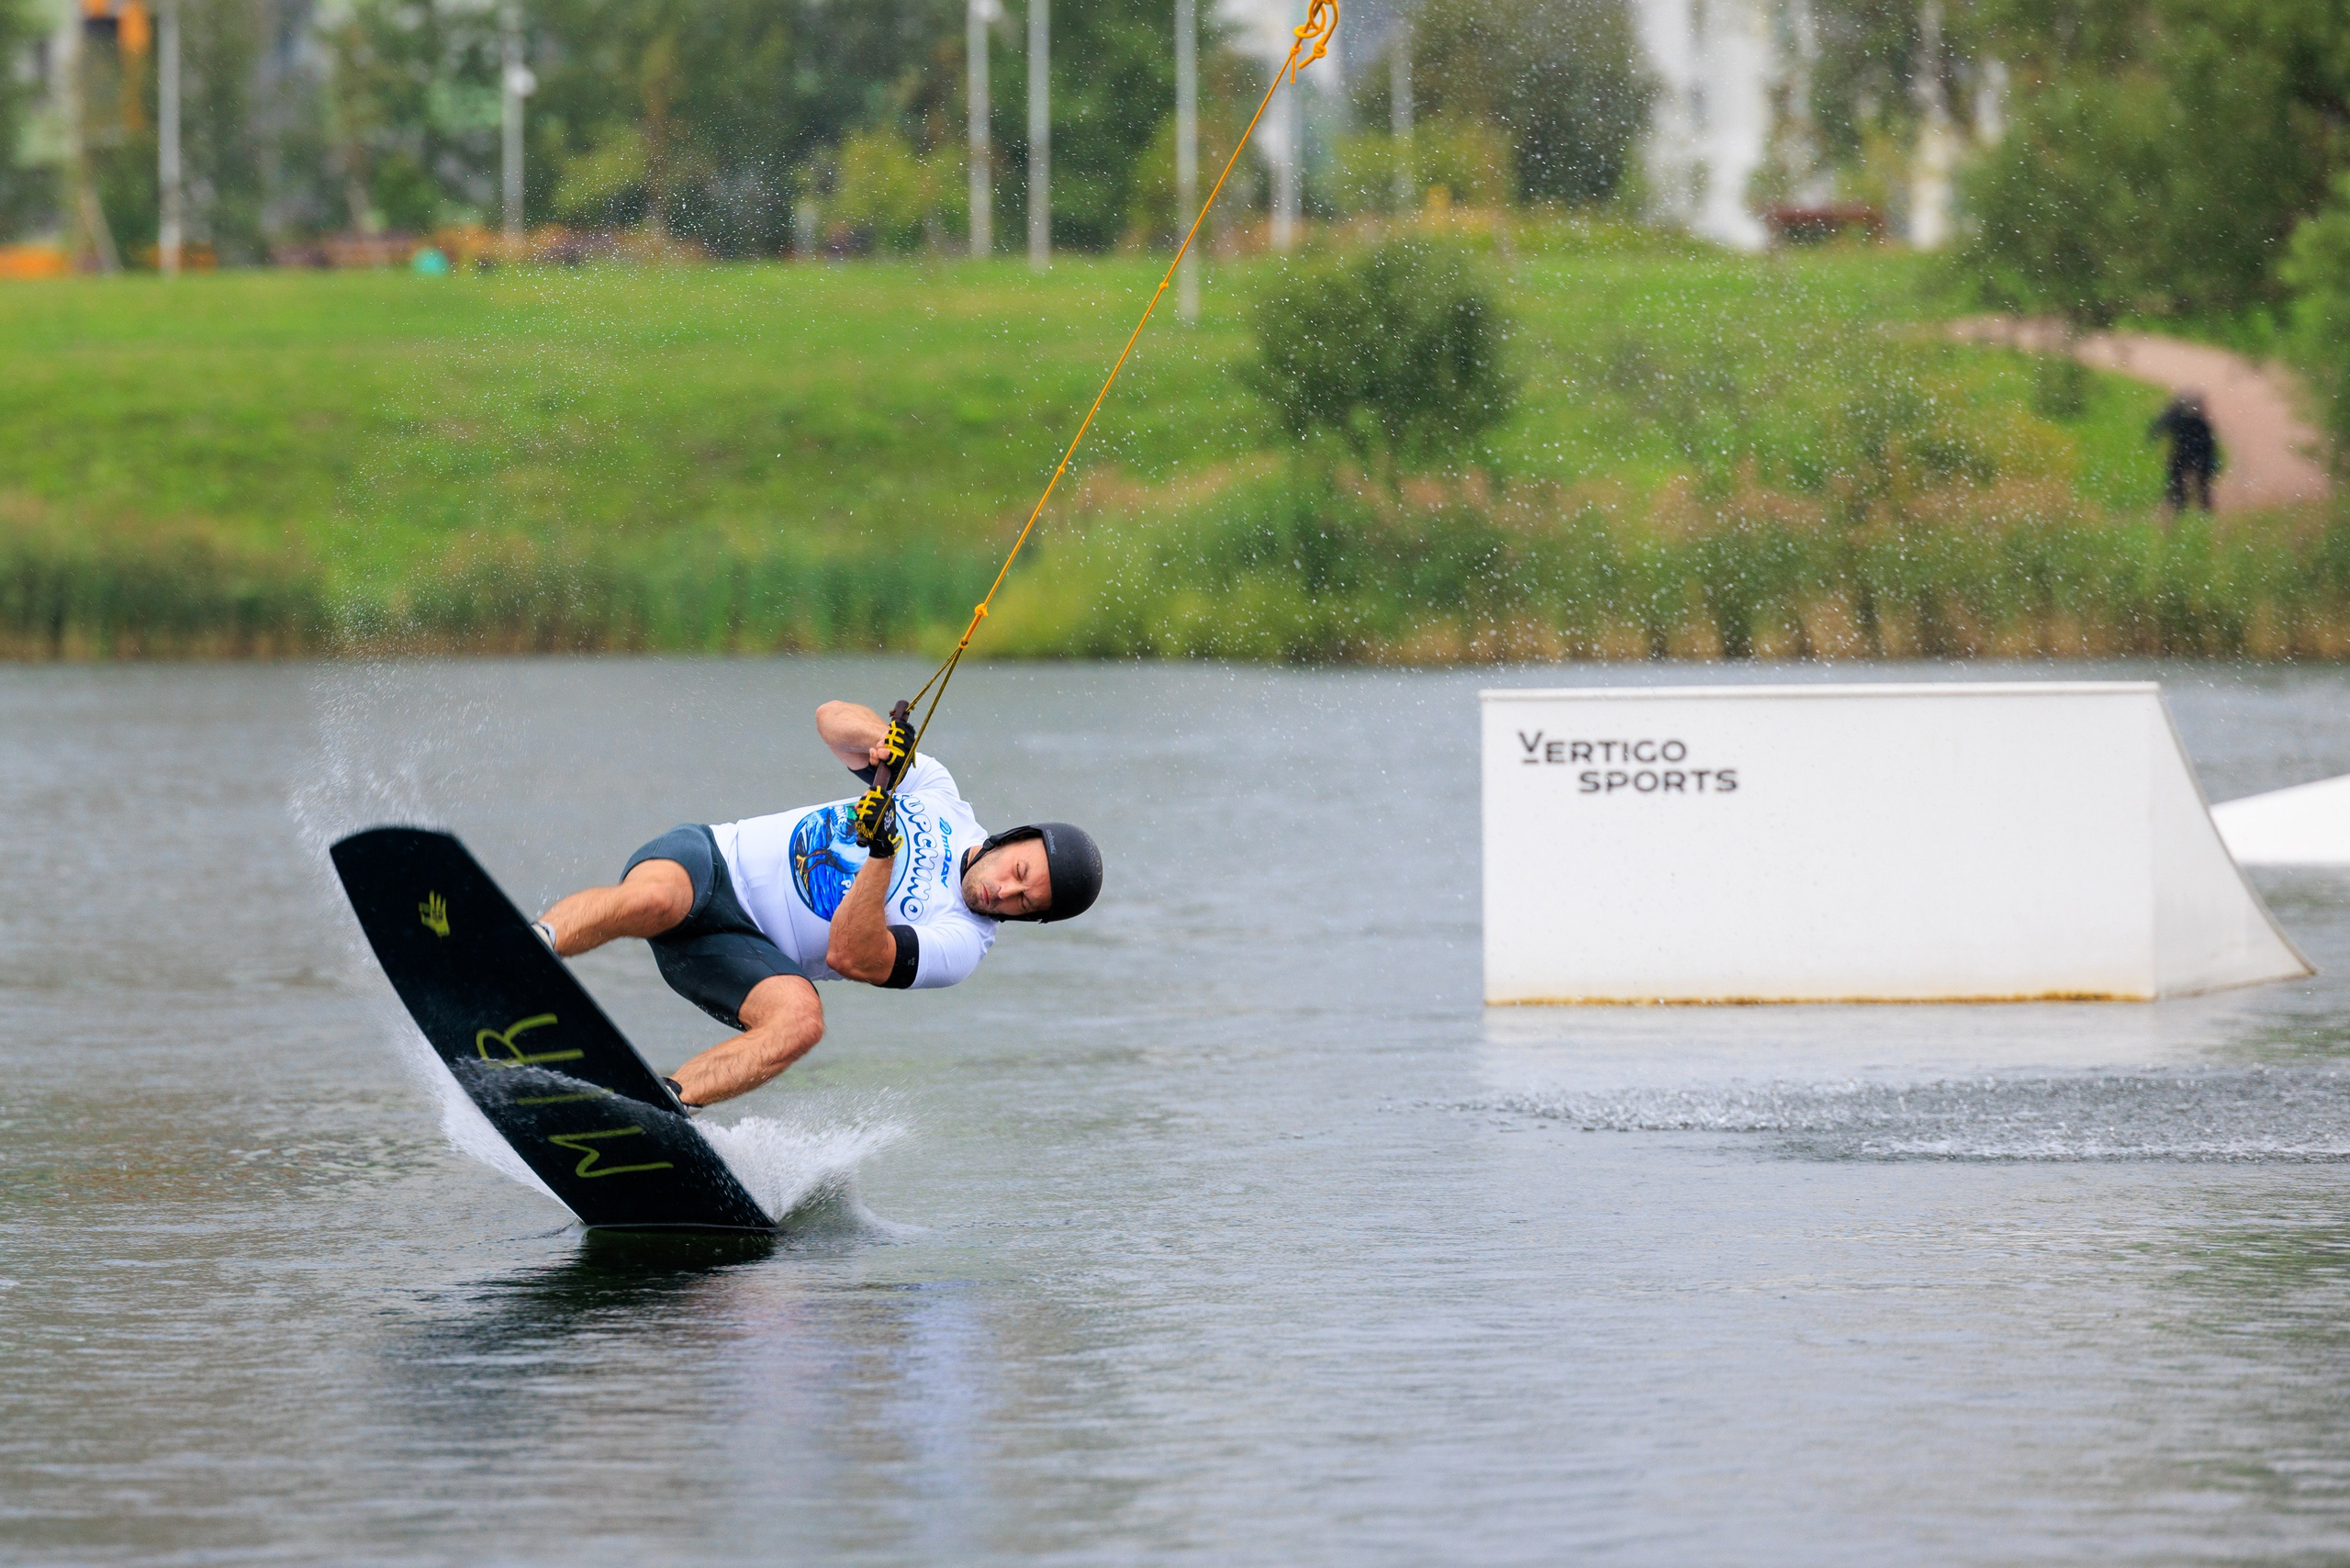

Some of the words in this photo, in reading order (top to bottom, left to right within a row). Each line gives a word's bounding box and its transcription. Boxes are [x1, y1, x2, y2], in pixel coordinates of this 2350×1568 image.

[1518, 731, 1687, 764] VERTIGO
[1578, 769, 1739, 793] SPORTS
[476, 1013, 675, 1179] MIR
